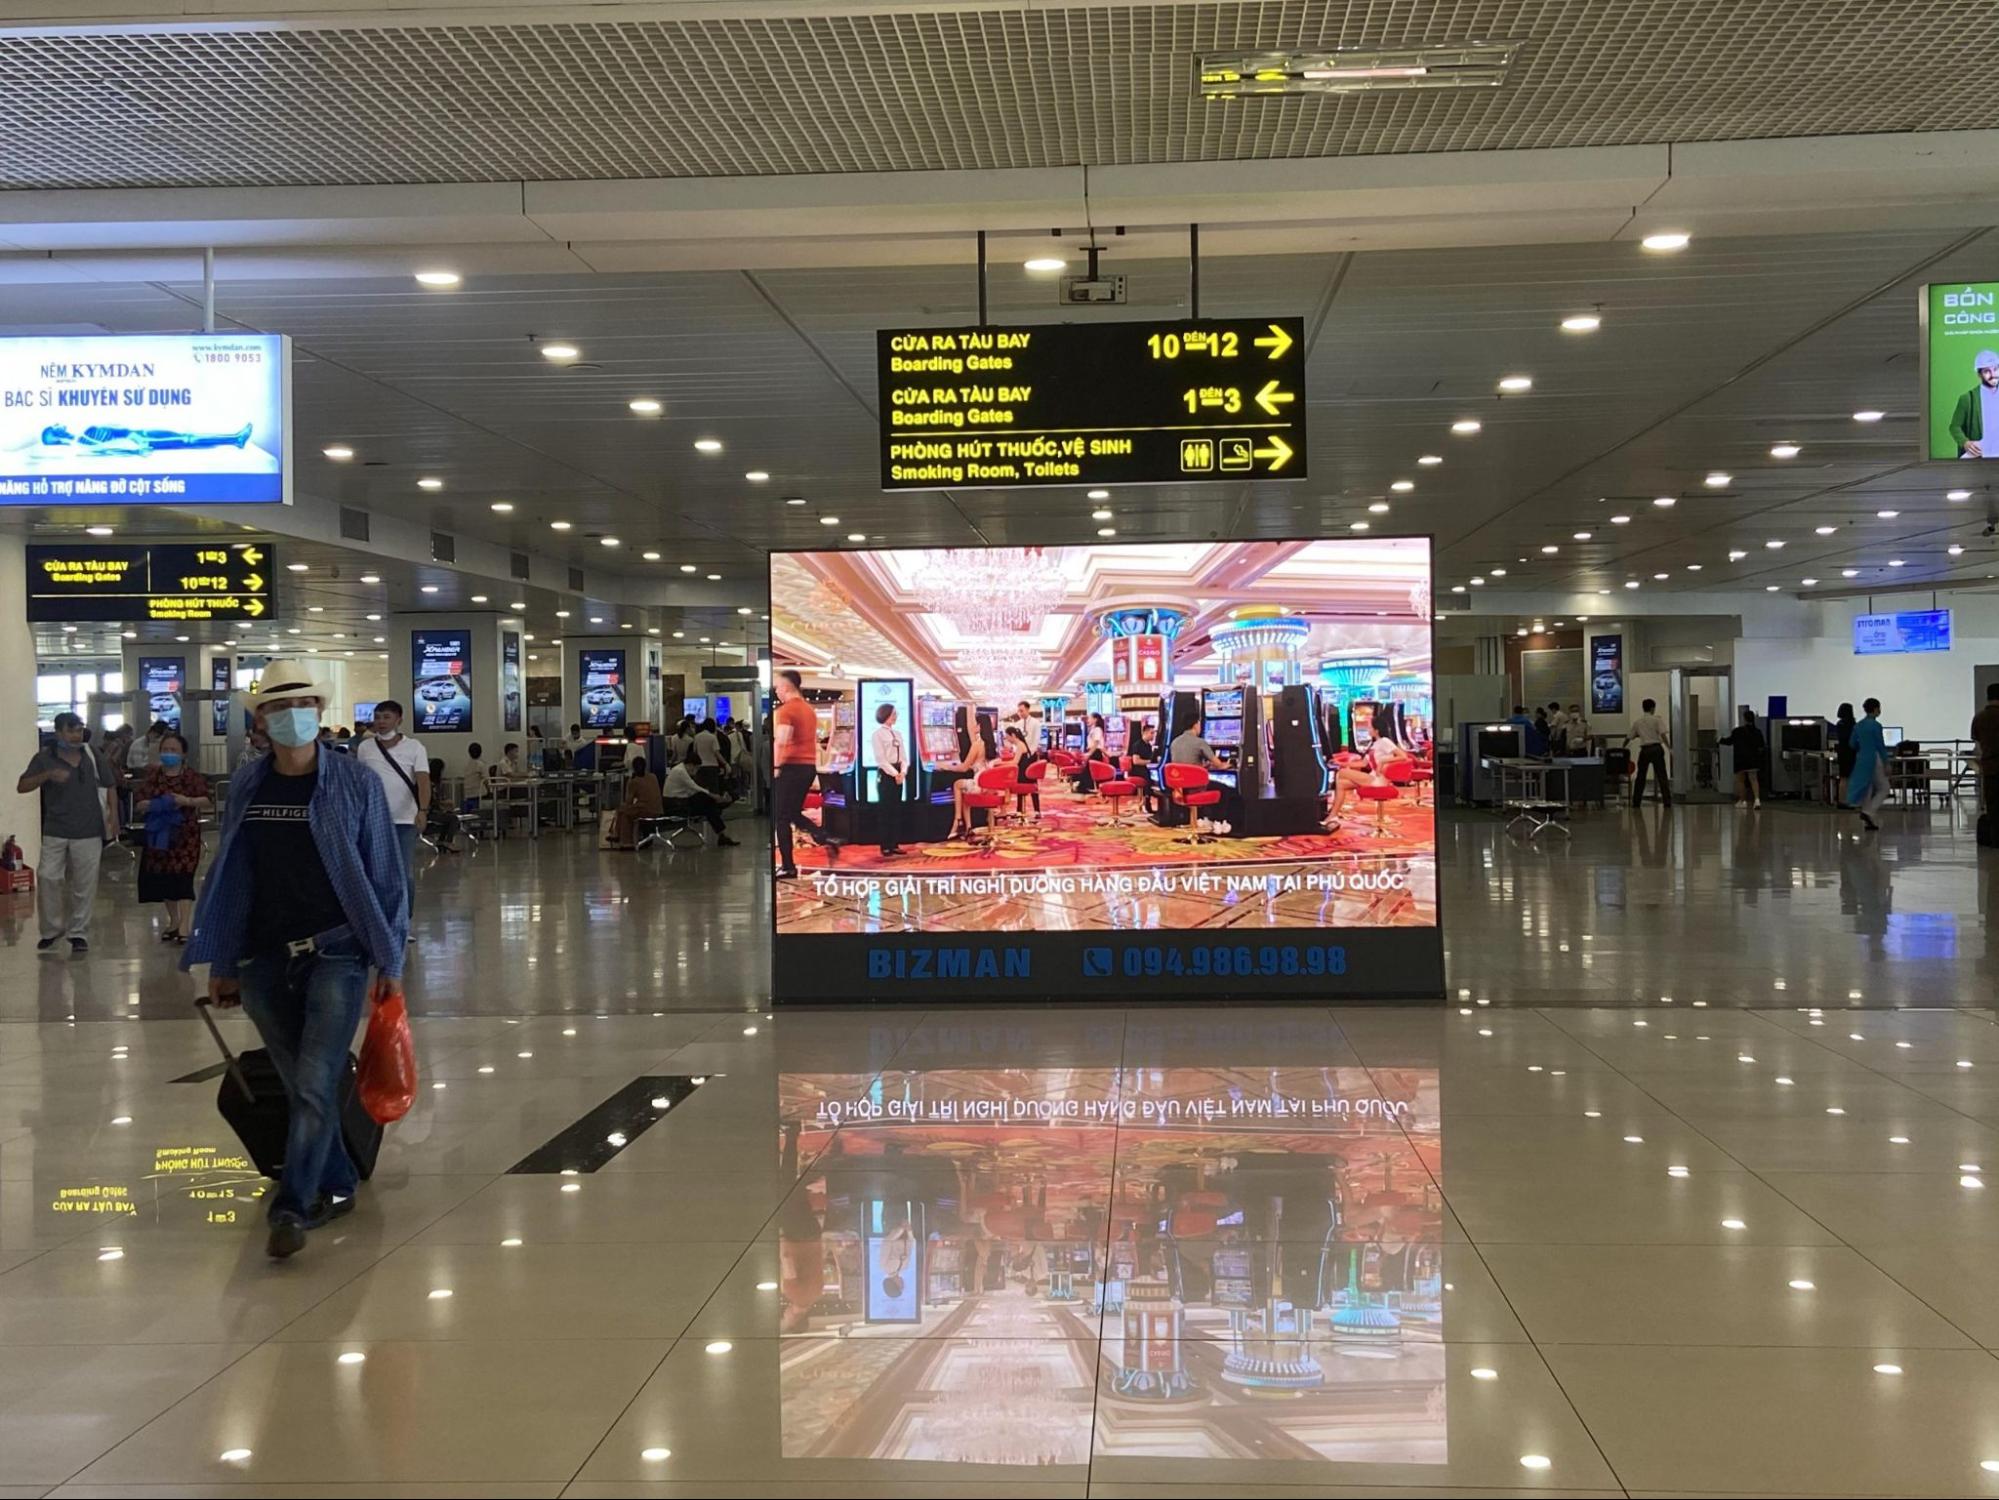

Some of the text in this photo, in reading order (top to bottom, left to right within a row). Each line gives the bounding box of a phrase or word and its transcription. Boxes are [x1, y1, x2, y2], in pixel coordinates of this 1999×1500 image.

[1944, 309, 1996, 325] CÔNG
[891, 332, 1031, 351] CỬA RA TÀU BAY
[1147, 334, 1180, 359] 10
[1206, 332, 1239, 357] 12
[205, 353, 261, 363] 1800 9053
[891, 355, 1013, 374] Boarding Gates
[71, 363, 155, 378] KYMDAN
[892, 385, 1032, 405] CỬA RA TÀU BAY
[1183, 389, 1197, 414] 1
[1224, 388, 1242, 413] 3
[892, 408, 1013, 427] Boarding Gates
[891, 441, 953, 459] PHÒNG
[957, 440, 993, 458] HÚT
[1089, 439, 1132, 455] SINH
[891, 461, 1080, 482] Smoking Room, Toilets
[68, 562, 83, 572] RA
[107, 561, 129, 572] BAY
[197, 551, 205, 564] 1
[217, 551, 228, 564] 3
[52, 573, 93, 583] Boarding
[181, 577, 197, 590] 10
[210, 577, 227, 590] 12
[188, 609, 212, 618] Room
[842, 878, 881, 898] HỢP
[1080, 872, 1132, 893] HÀNG
[1182, 872, 1222, 893] VIỆT
[1227, 875, 1267, 891] NAM
[1272, 875, 1301, 894] TẠI
[1307, 871, 1344, 890] PHÚ
[1349, 869, 1405, 890] QUỐC
[868, 946, 1347, 979] BIZMAN 094.986.98.98
